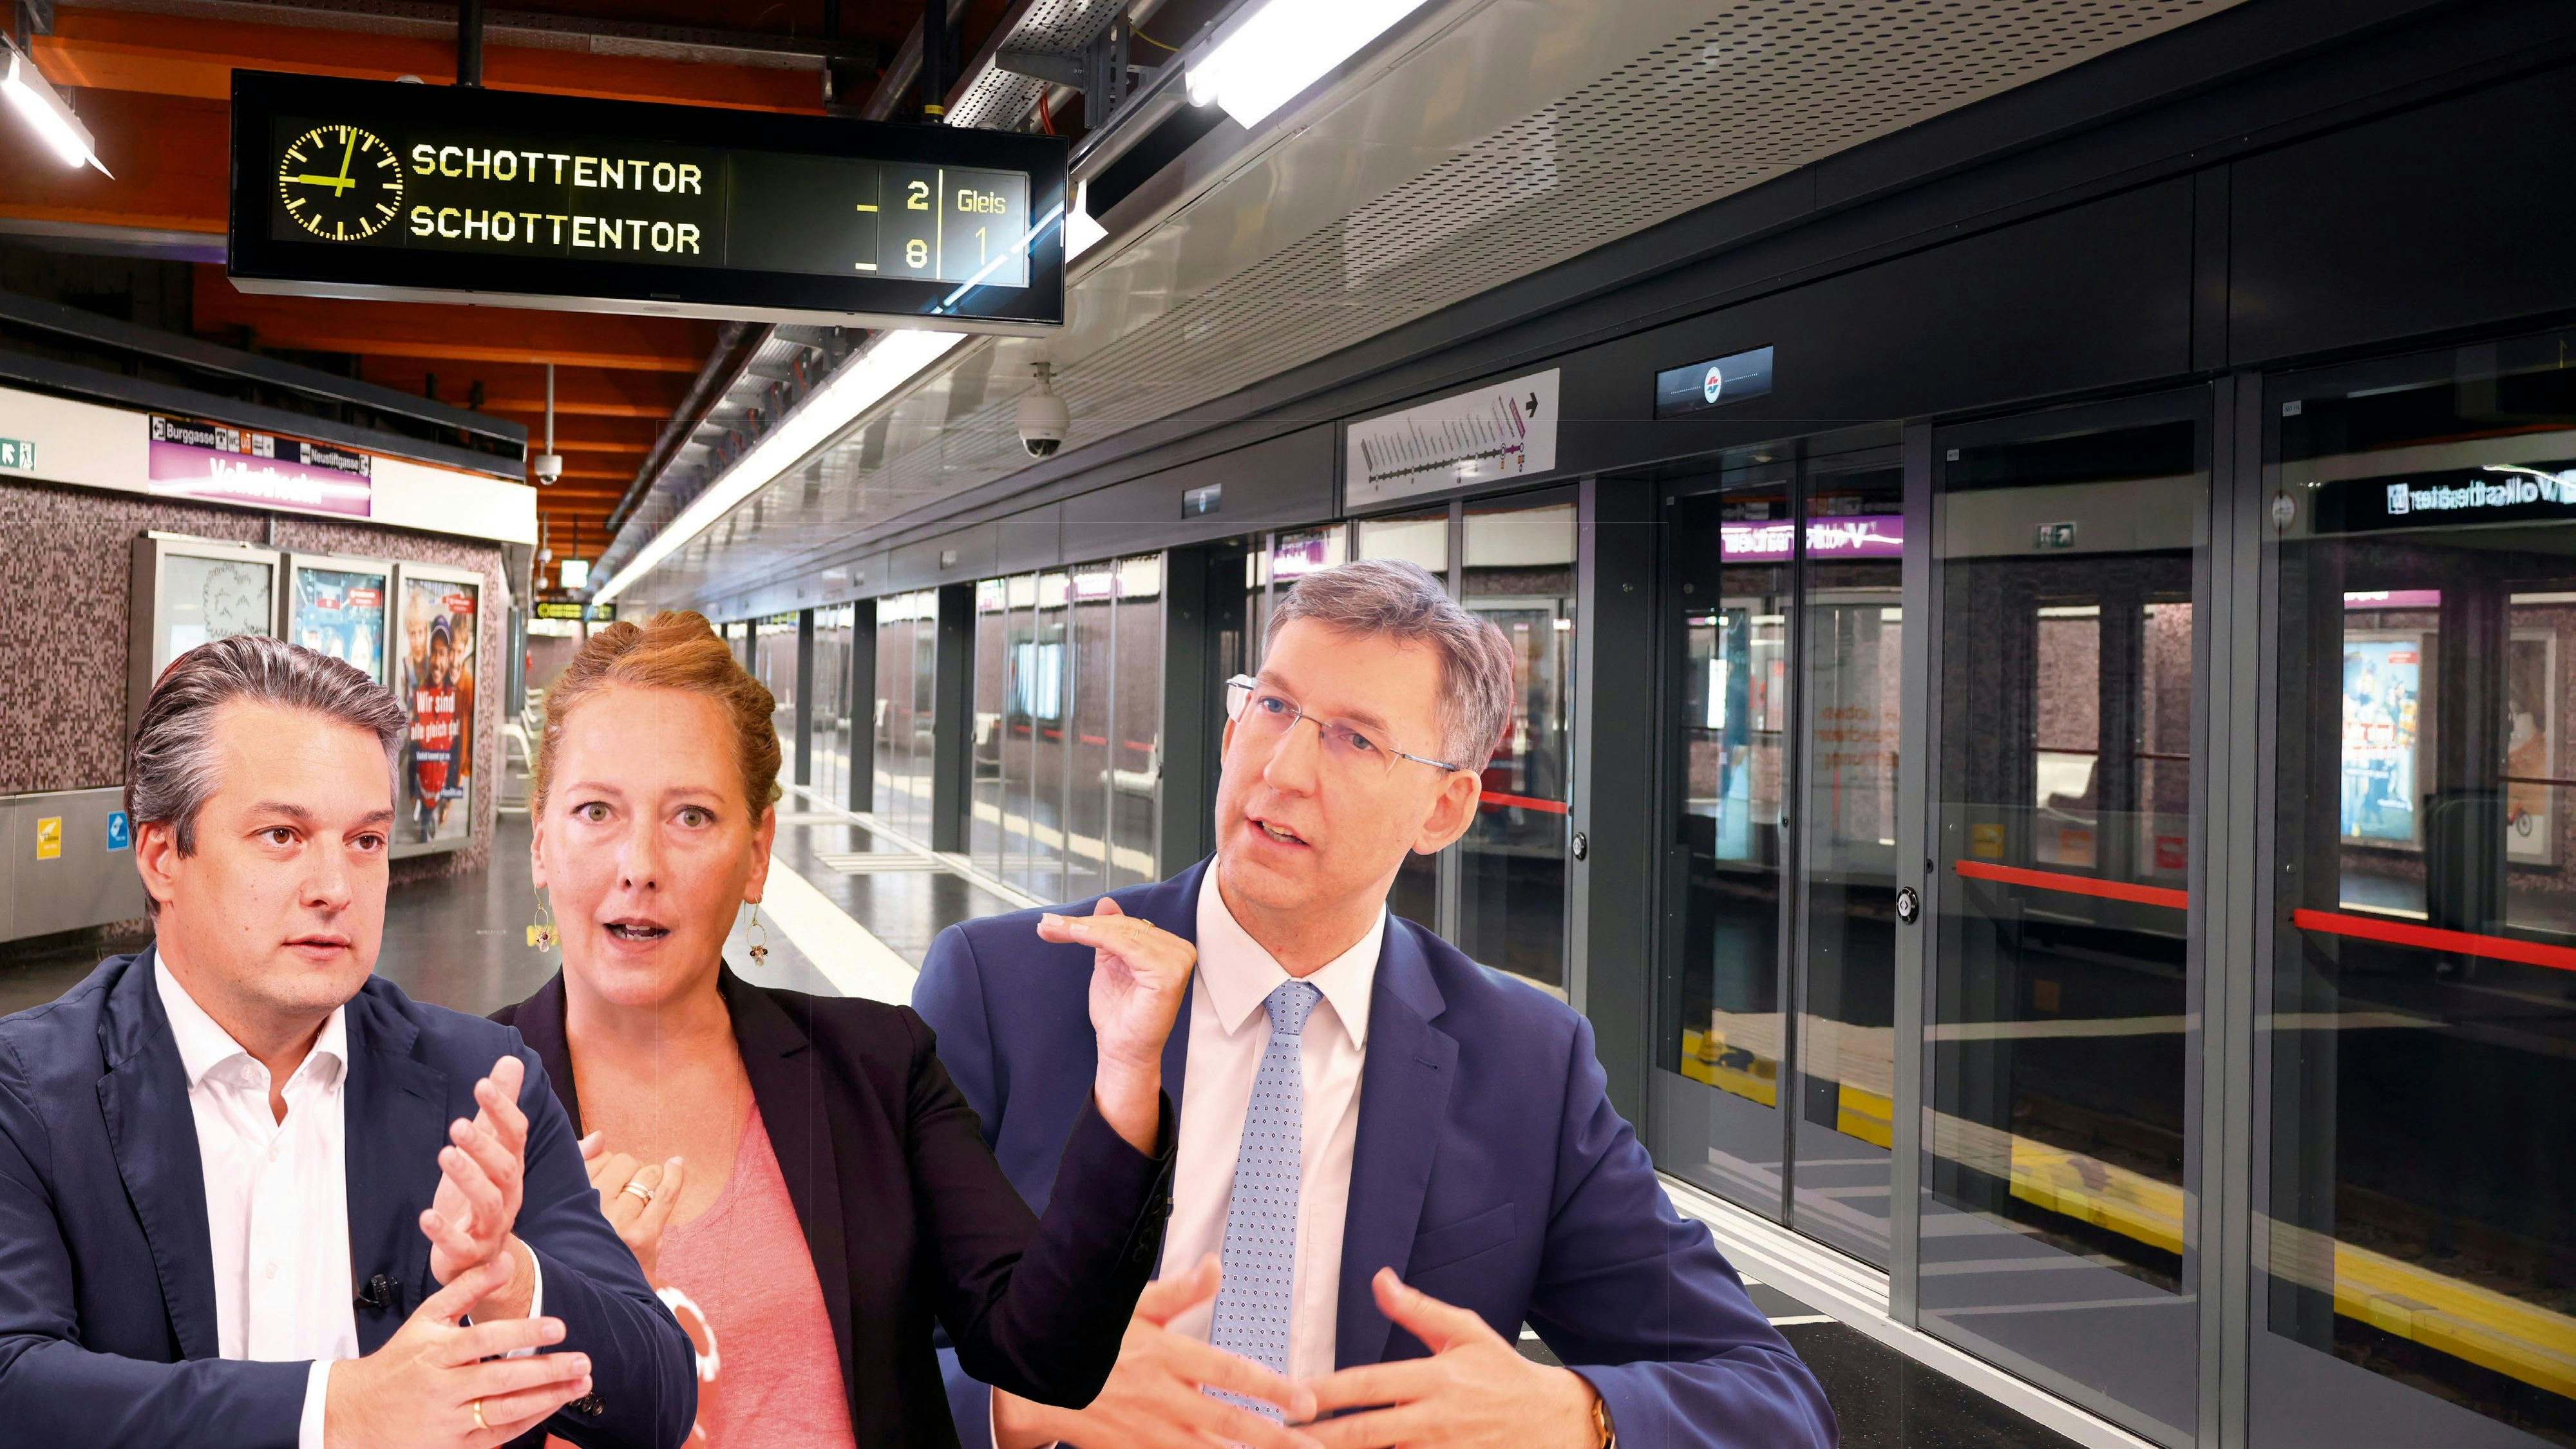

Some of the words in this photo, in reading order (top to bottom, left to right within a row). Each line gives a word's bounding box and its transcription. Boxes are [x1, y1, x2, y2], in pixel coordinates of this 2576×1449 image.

[412, 144, 701, 194] SCHOTTENTOR
[907, 180, 929, 211] 2
[958, 189, 1006, 214] Gleis
[410, 205, 700, 254] SCHOTTENTOR
[906, 238, 927, 269] 8
[975, 226, 987, 266] 1
[167, 422, 215, 445] Burggasse
[311, 448, 359, 471] Neustiftgasse
[416, 690, 434, 714] Wir
[435, 690, 455, 714] sind
[411, 722, 424, 741] alle
[426, 720, 448, 743] gleich
